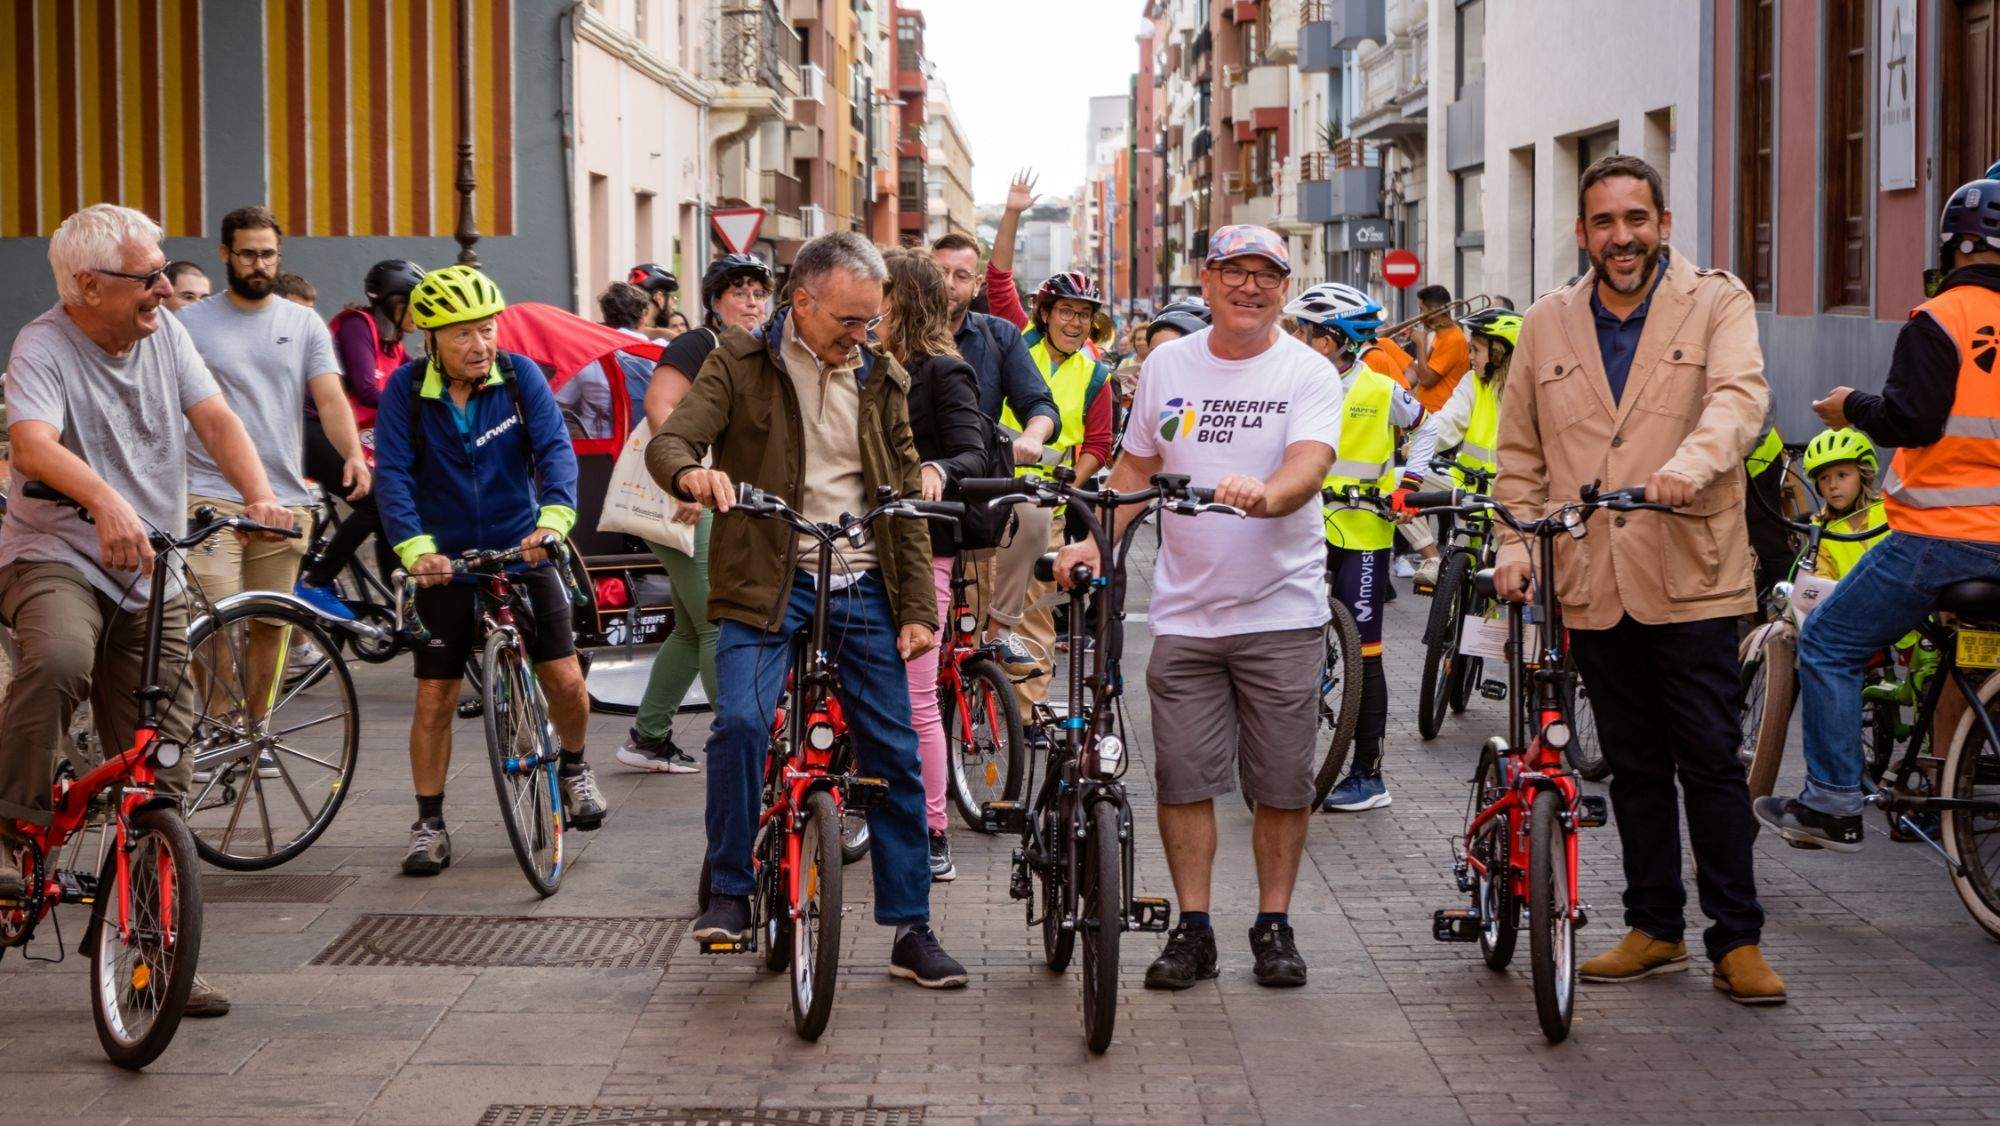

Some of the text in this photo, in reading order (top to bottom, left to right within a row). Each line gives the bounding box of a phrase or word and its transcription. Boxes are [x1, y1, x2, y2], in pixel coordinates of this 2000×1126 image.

[1202, 400, 1288, 414] TENERIFE
[1199, 415, 1263, 428] POR LA
[1197, 430, 1234, 443] BICI
[1359, 550, 1374, 598] movist
